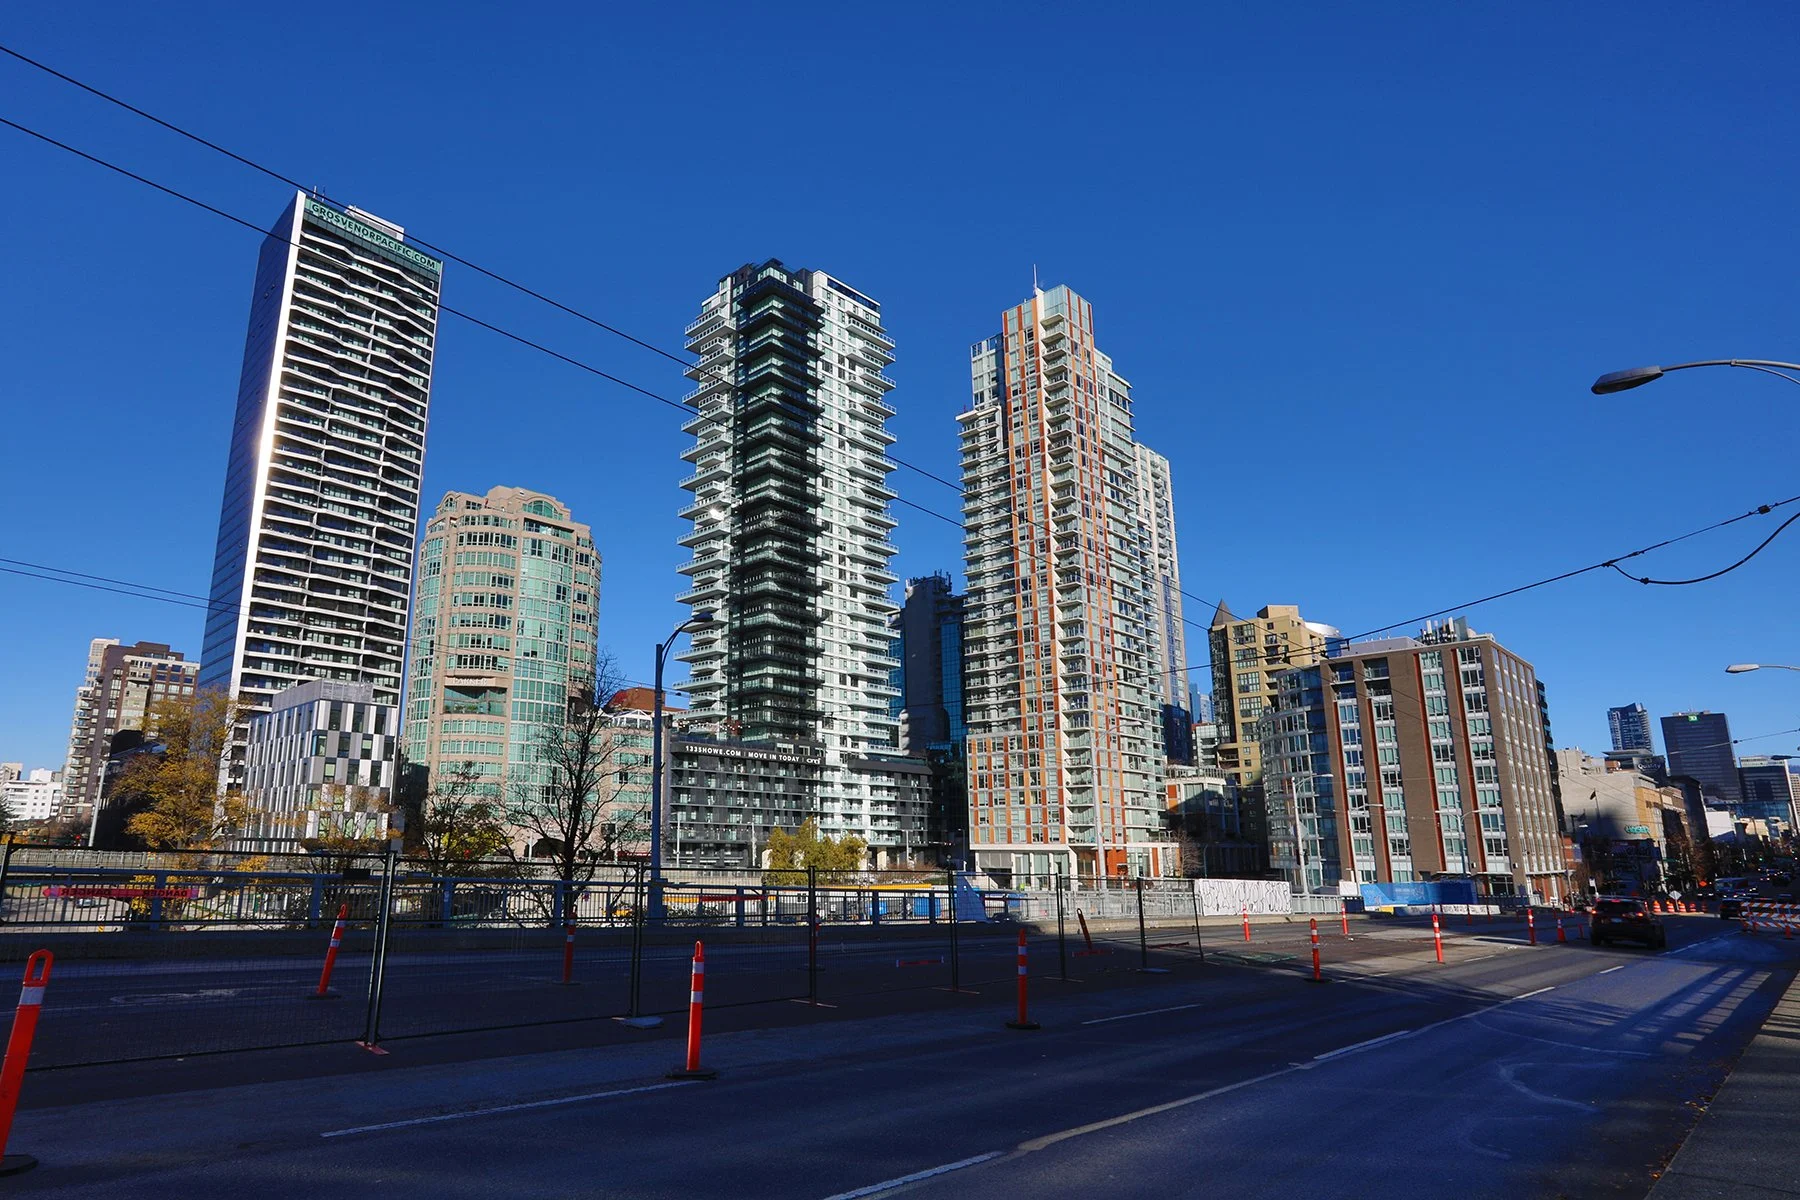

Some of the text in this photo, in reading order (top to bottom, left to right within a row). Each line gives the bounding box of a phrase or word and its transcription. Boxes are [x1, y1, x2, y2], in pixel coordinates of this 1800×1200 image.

[311, 203, 436, 269] GROSVENORPACIFIC.COM
[685, 745, 741, 757] 1335HOWE.COM
[748, 751, 768, 760] MOVE
[779, 755, 800, 763] TODAY
